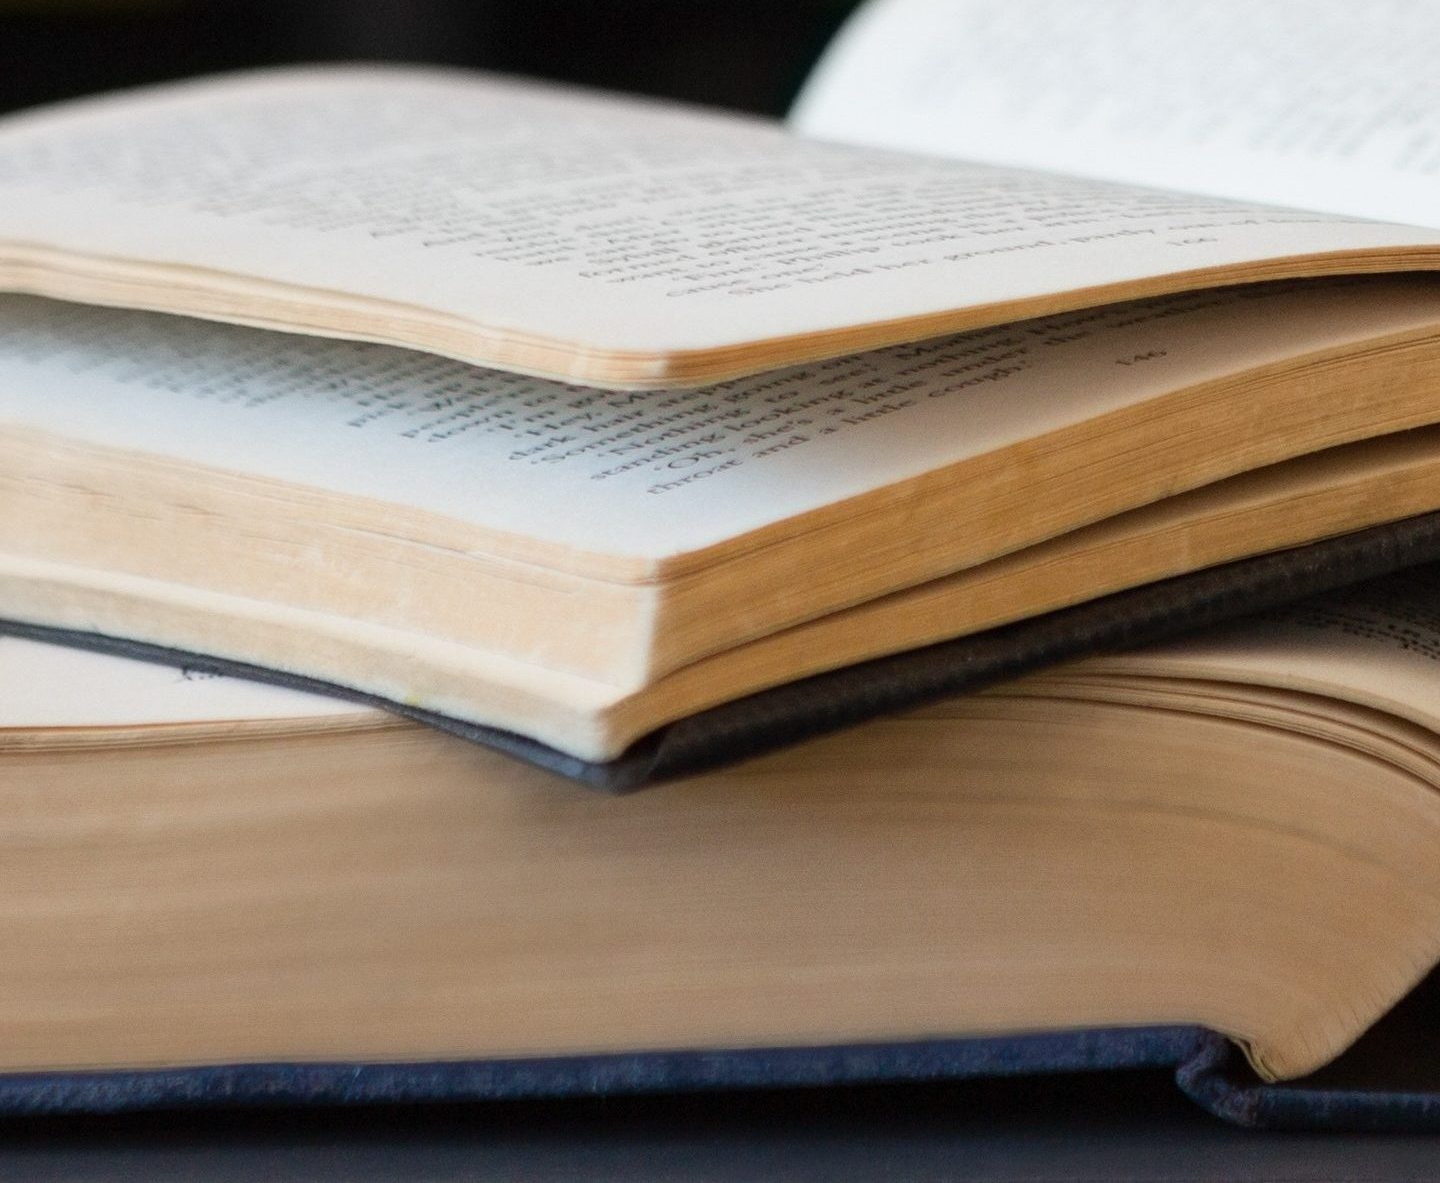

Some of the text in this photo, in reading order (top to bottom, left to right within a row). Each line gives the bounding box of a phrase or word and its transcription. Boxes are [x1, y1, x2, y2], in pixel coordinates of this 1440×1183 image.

[508, 435, 577, 461] dark
[590, 432, 726, 480] standing
[723, 389, 854, 432] looking
[646, 459, 744, 495] throat
[840, 399, 917, 426] little
